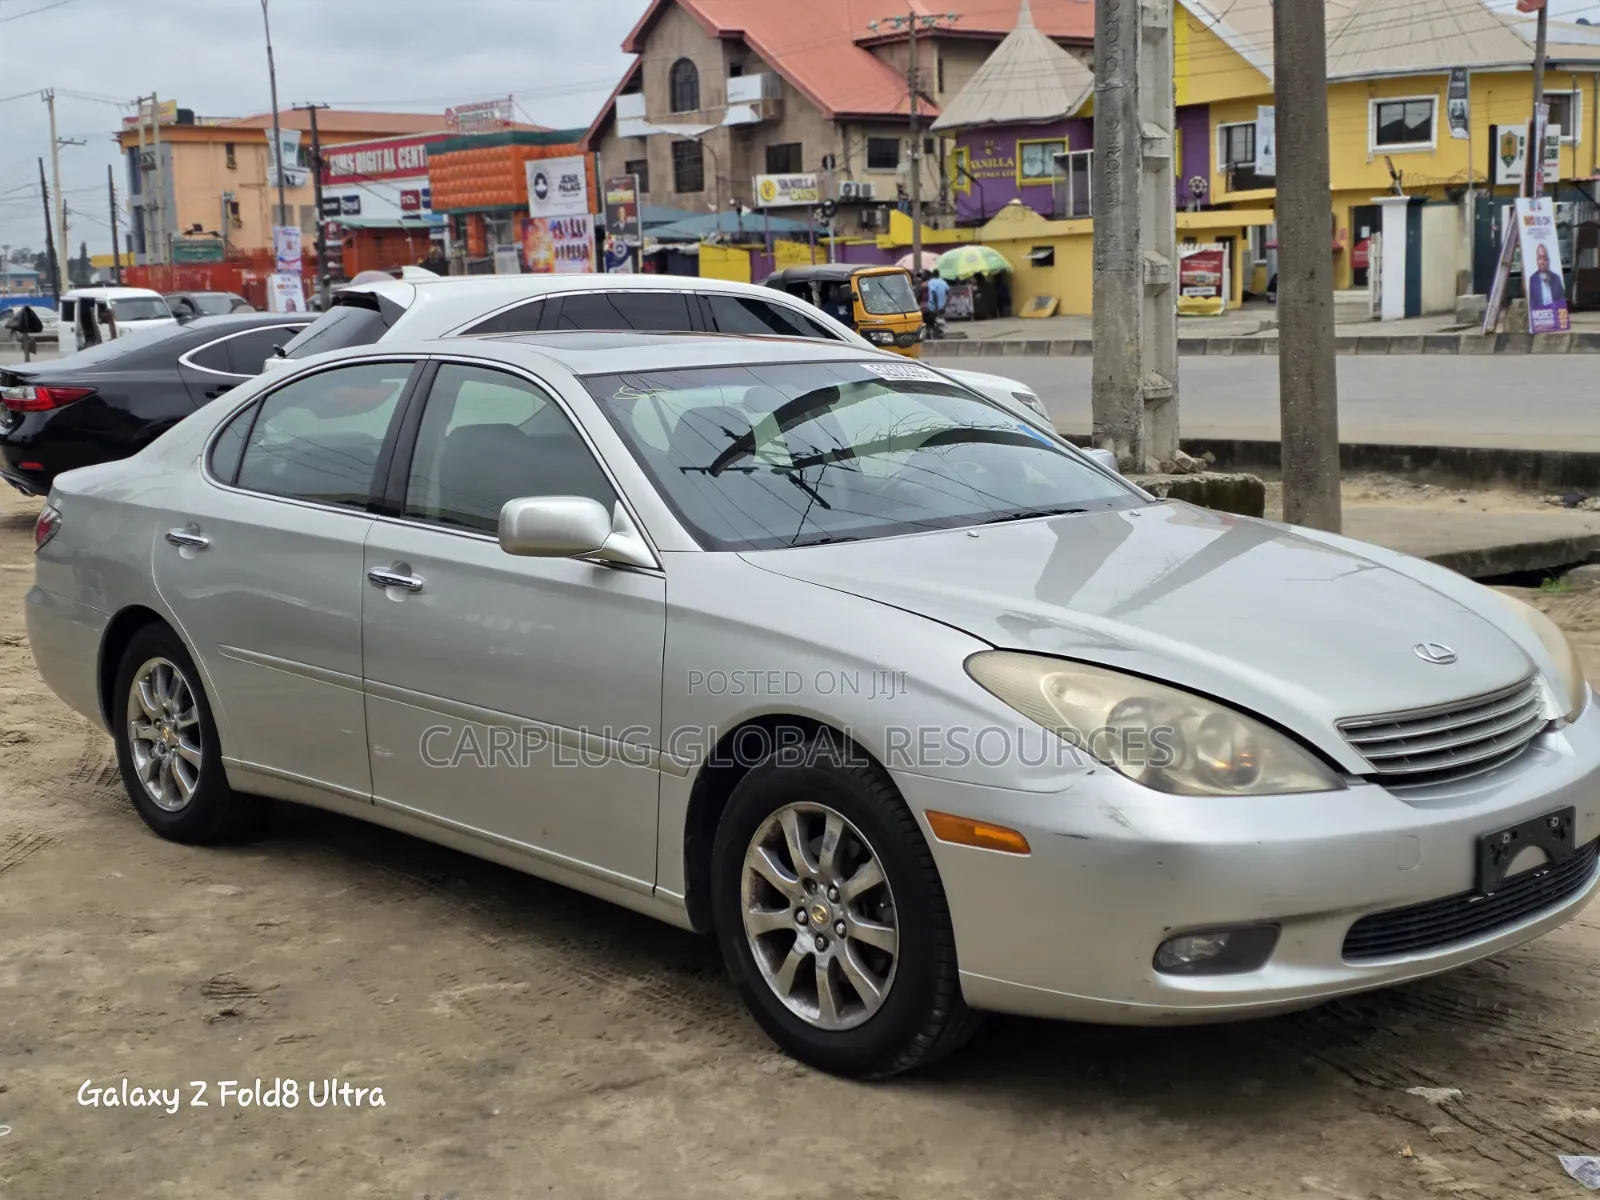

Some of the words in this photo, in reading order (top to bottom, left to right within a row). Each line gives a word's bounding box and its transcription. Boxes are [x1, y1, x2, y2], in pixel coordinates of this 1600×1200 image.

[329, 153, 355, 176] SIMS
[355, 147, 397, 174] DIGITAL
[970, 156, 1015, 169] VANILLA
[776, 177, 816, 190] VANILLA
